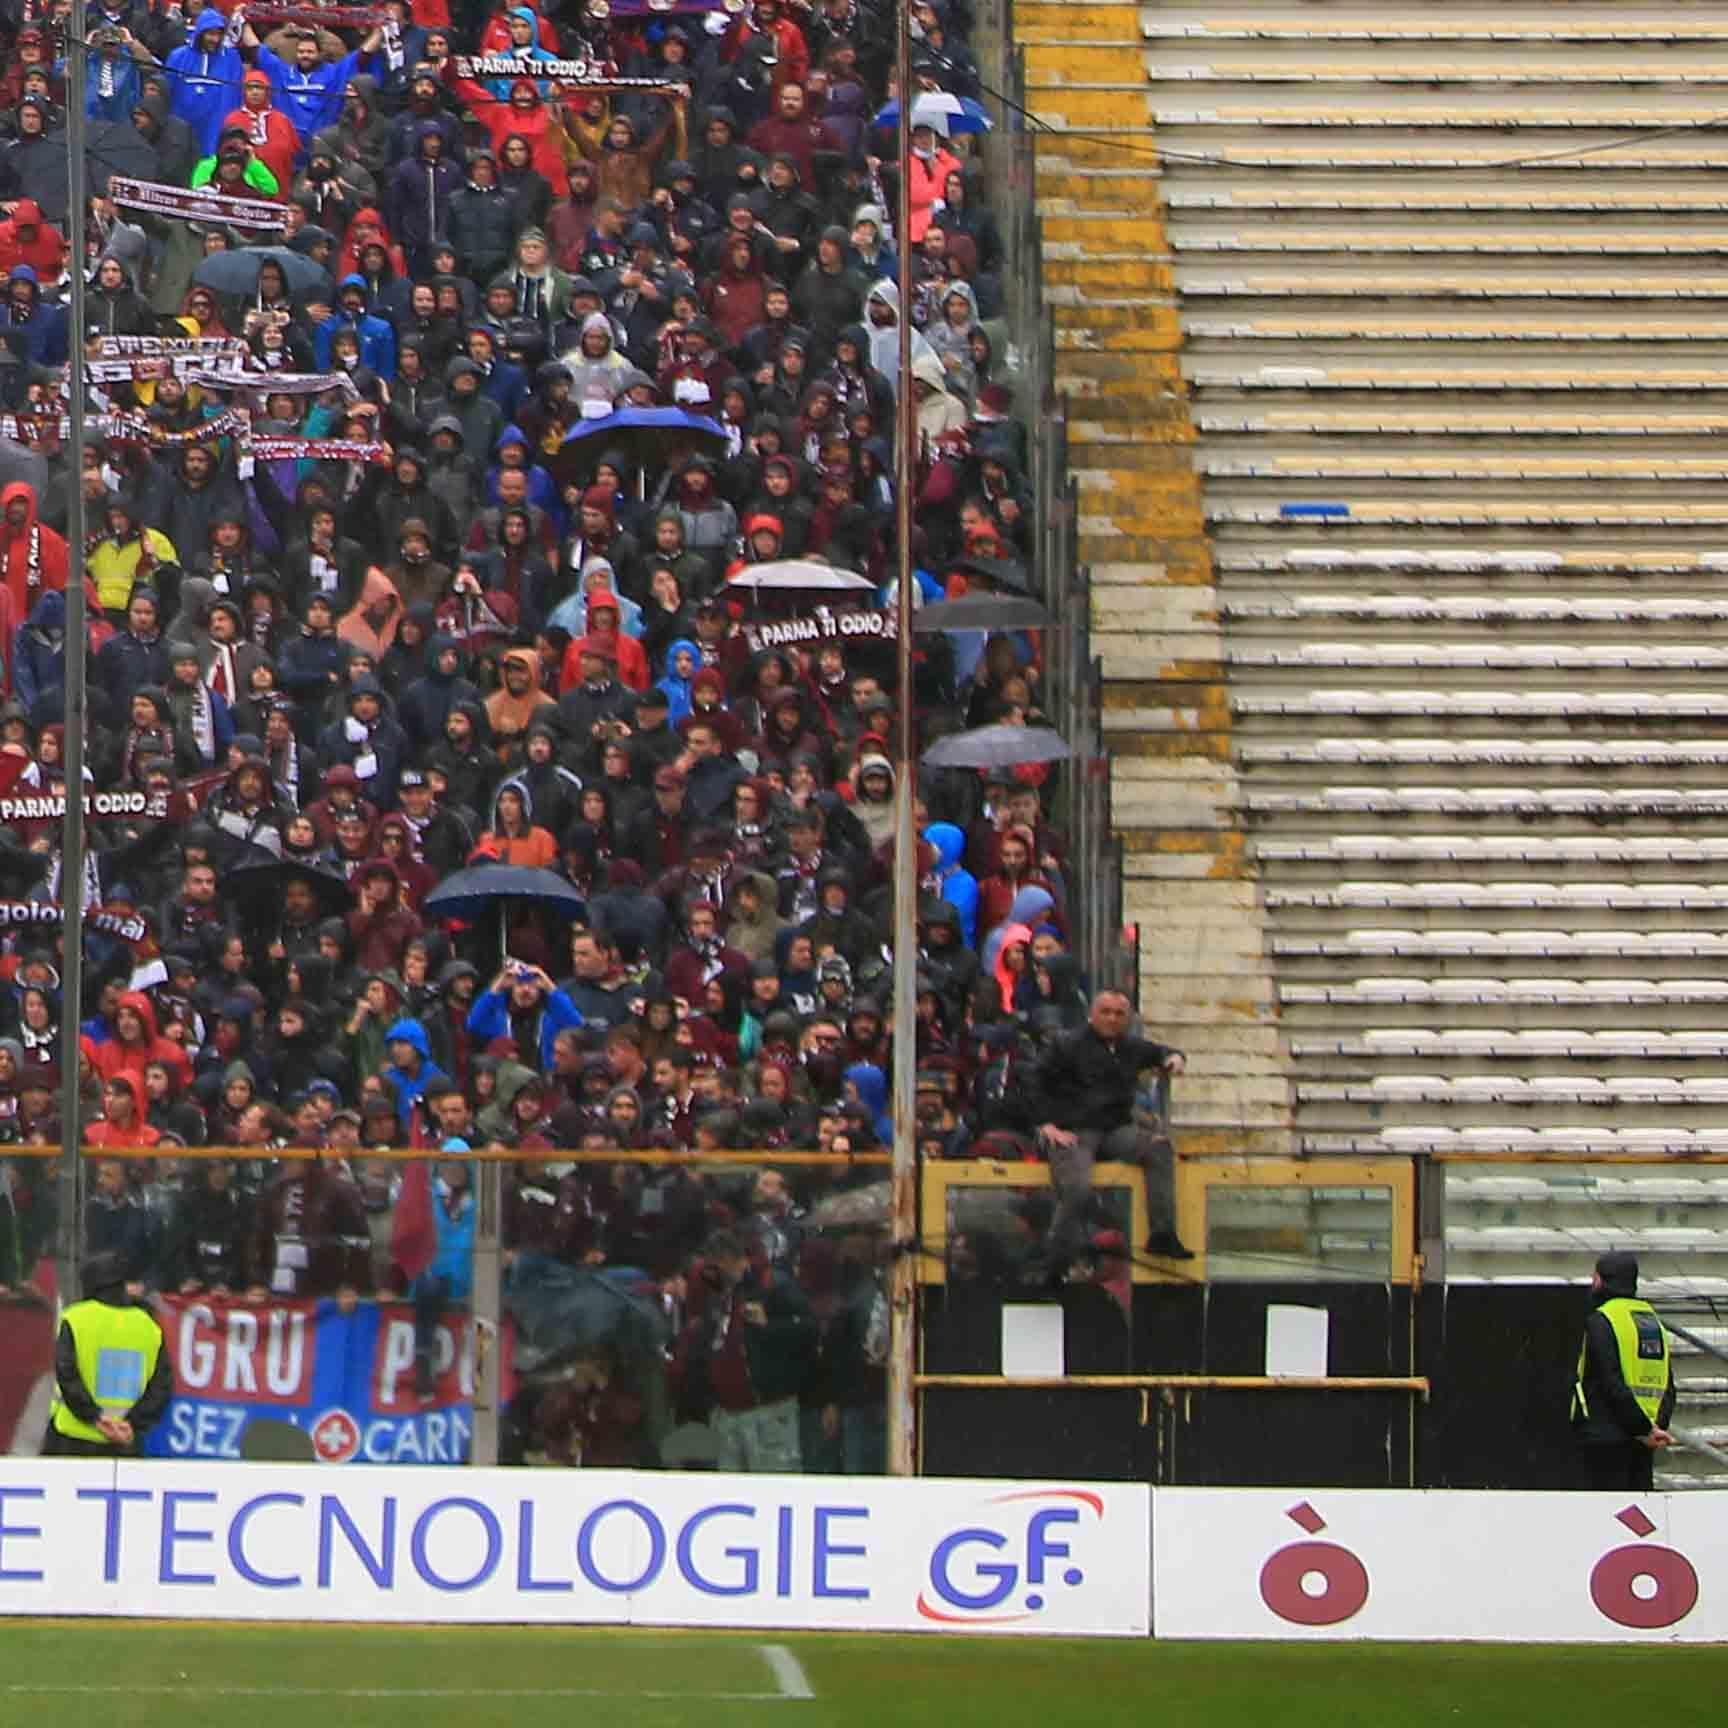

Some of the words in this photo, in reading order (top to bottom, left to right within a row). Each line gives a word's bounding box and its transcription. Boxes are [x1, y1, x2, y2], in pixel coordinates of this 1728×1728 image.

[472, 57, 525, 76] PARMA
[548, 59, 587, 79] ODIO
[762, 622, 820, 648] PARMA
[841, 614, 882, 638] ODIO
[1, 797, 67, 820] PARMA
[96, 793, 145, 815] ODIO
[180, 1300, 305, 1396] GRU
[77, 1487, 871, 1600] TECNOLOGIE
